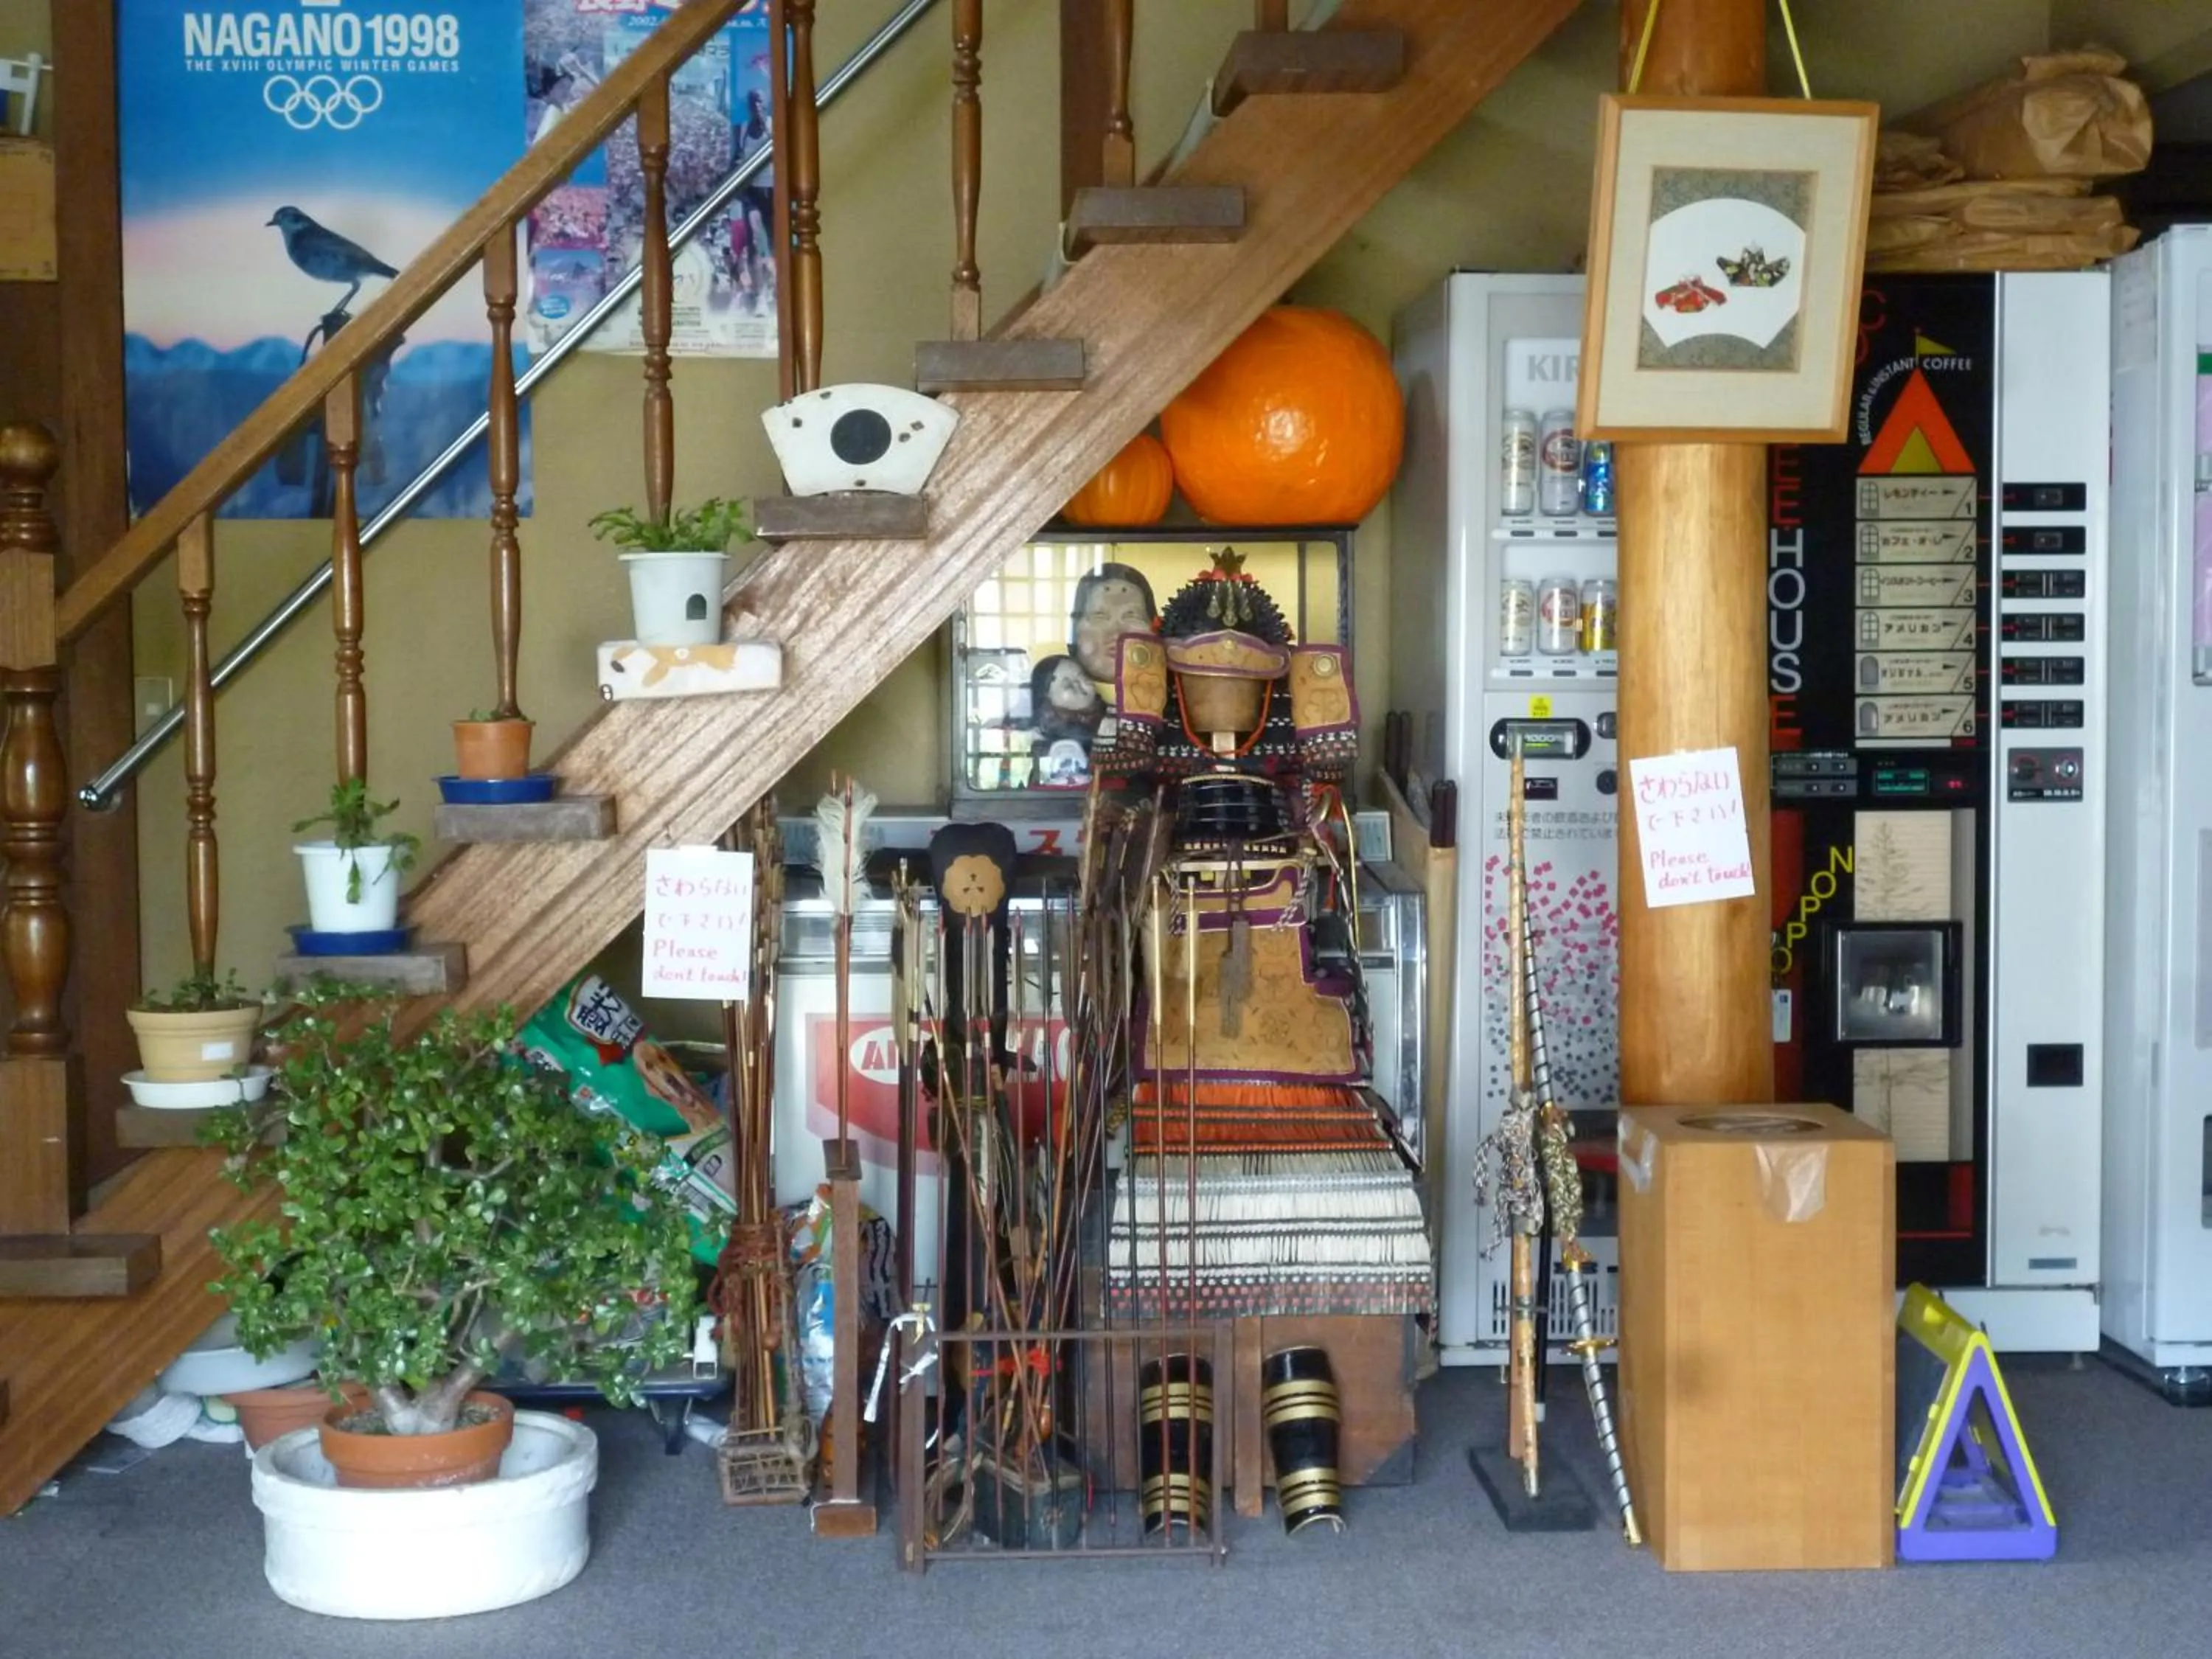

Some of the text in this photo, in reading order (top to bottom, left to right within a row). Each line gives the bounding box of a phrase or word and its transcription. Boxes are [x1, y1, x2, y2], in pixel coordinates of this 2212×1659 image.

[184, 13, 459, 58] NAGANO 1998
[186, 60, 460, 72] THE XVIII OLYMPIC WINTER GAMES
[1871, 357, 1916, 388] INSTANT
[1922, 358, 1973, 371] COFFEE
[1965, 501, 1972, 515] 1
[1963, 546, 1973, 558] 2
[1963, 588, 1973, 602] 3
[1963, 633, 1973, 645] 4
[1963, 677, 1973, 690] 5
[1963, 720, 1973, 734] 6
[1649, 849, 1710, 869] Please
[653, 939, 718, 959] Please
